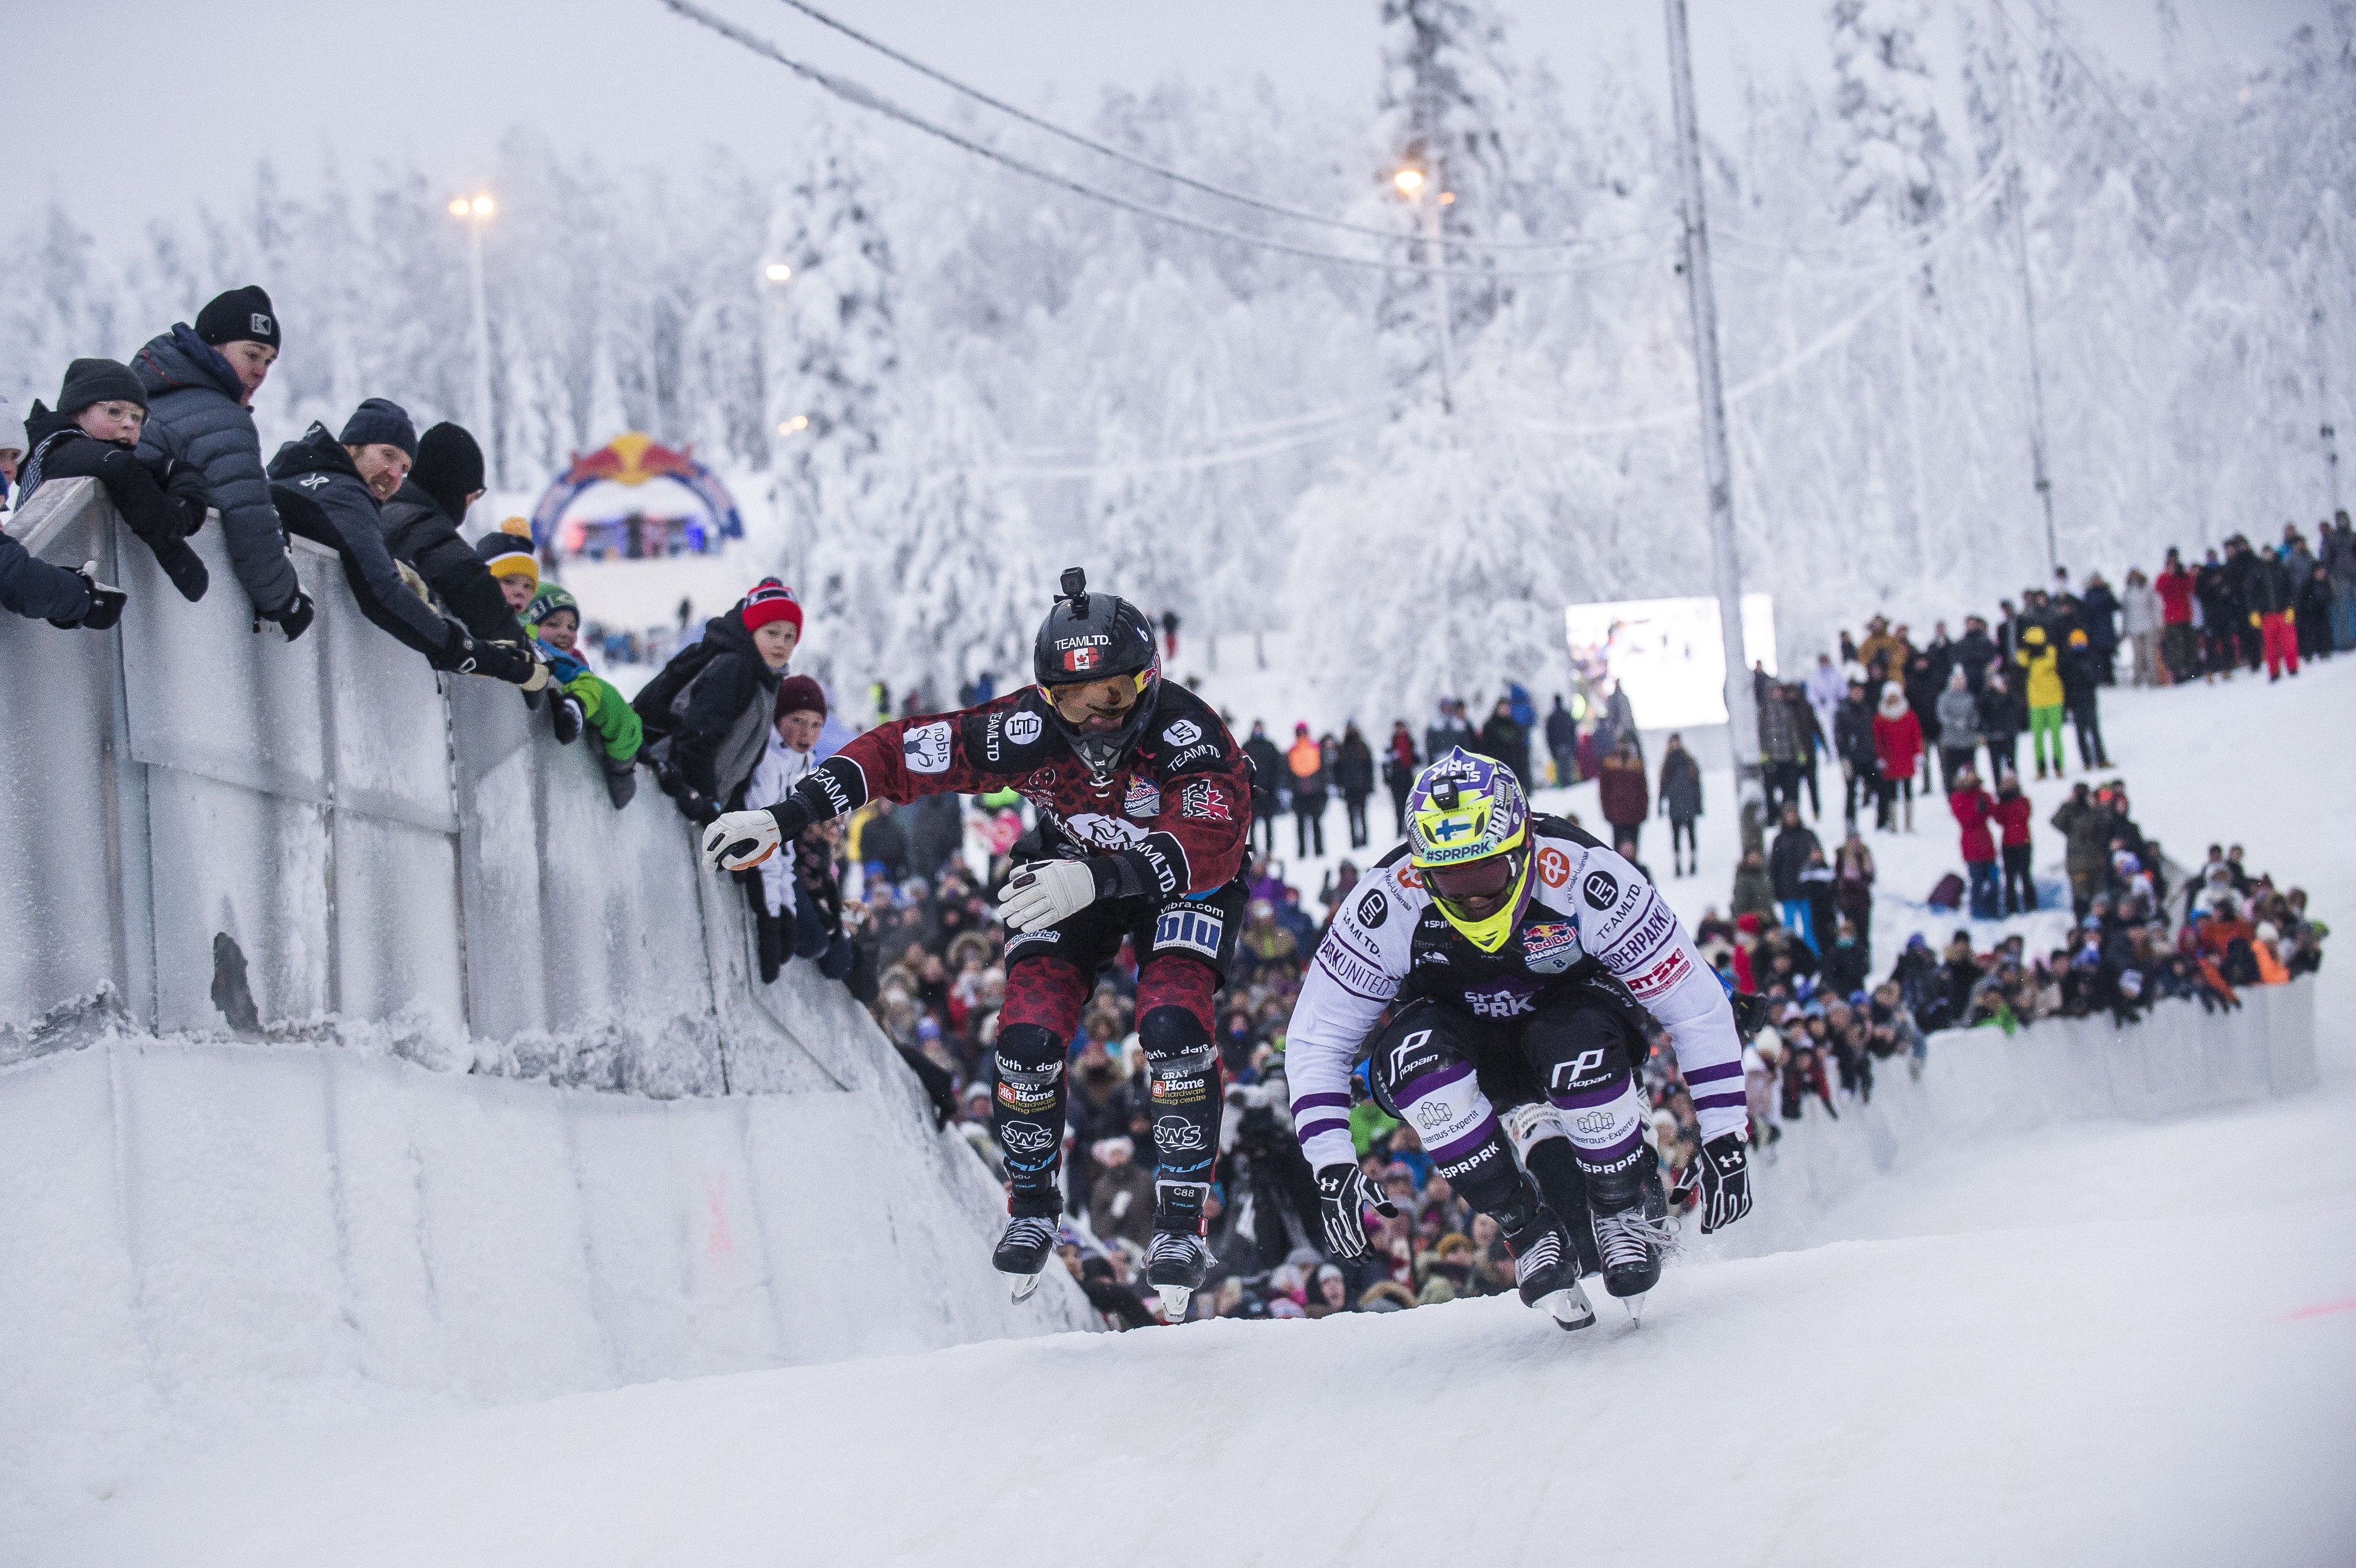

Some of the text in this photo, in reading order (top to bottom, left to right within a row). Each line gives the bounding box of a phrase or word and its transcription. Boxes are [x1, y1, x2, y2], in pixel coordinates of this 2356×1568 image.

[934, 727, 950, 764] nobis
[1134, 785, 1160, 798] Bull
[1426, 842, 1491, 862] #SPRPRK
[1160, 902, 1224, 918] vibra.com
[1156, 912, 1220, 952] blu
[1524, 927, 1579, 952] Red Bull
[1005, 930, 1060, 953] BFGoodrich
[1524, 945, 1569, 961] CRASHED
[1553, 958, 1566, 968] 8
[1473, 995, 1536, 1017] PRK
[1180, 1044, 1209, 1054] dare
[1162, 1070, 1189, 1080] GRAY
[1399, 1054, 1438, 1080] nopain
[1011, 1082, 1040, 1091] GRAY
[1165, 1079, 1205, 1091] Home
[1567, 1072, 1612, 1090] nopain
[1015, 1090, 1054, 1102] Home
[1151, 1095, 1206, 1106] building centre
[1165, 1088, 1206, 1097] hardware
[1015, 1096, 1056, 1107] hardware
[1001, 1124, 1053, 1147] SWS
[1153, 1124, 1201, 1146] SWS
[1160, 1157, 1213, 1173] RUE
[1174, 1187, 1194, 1197] C88
